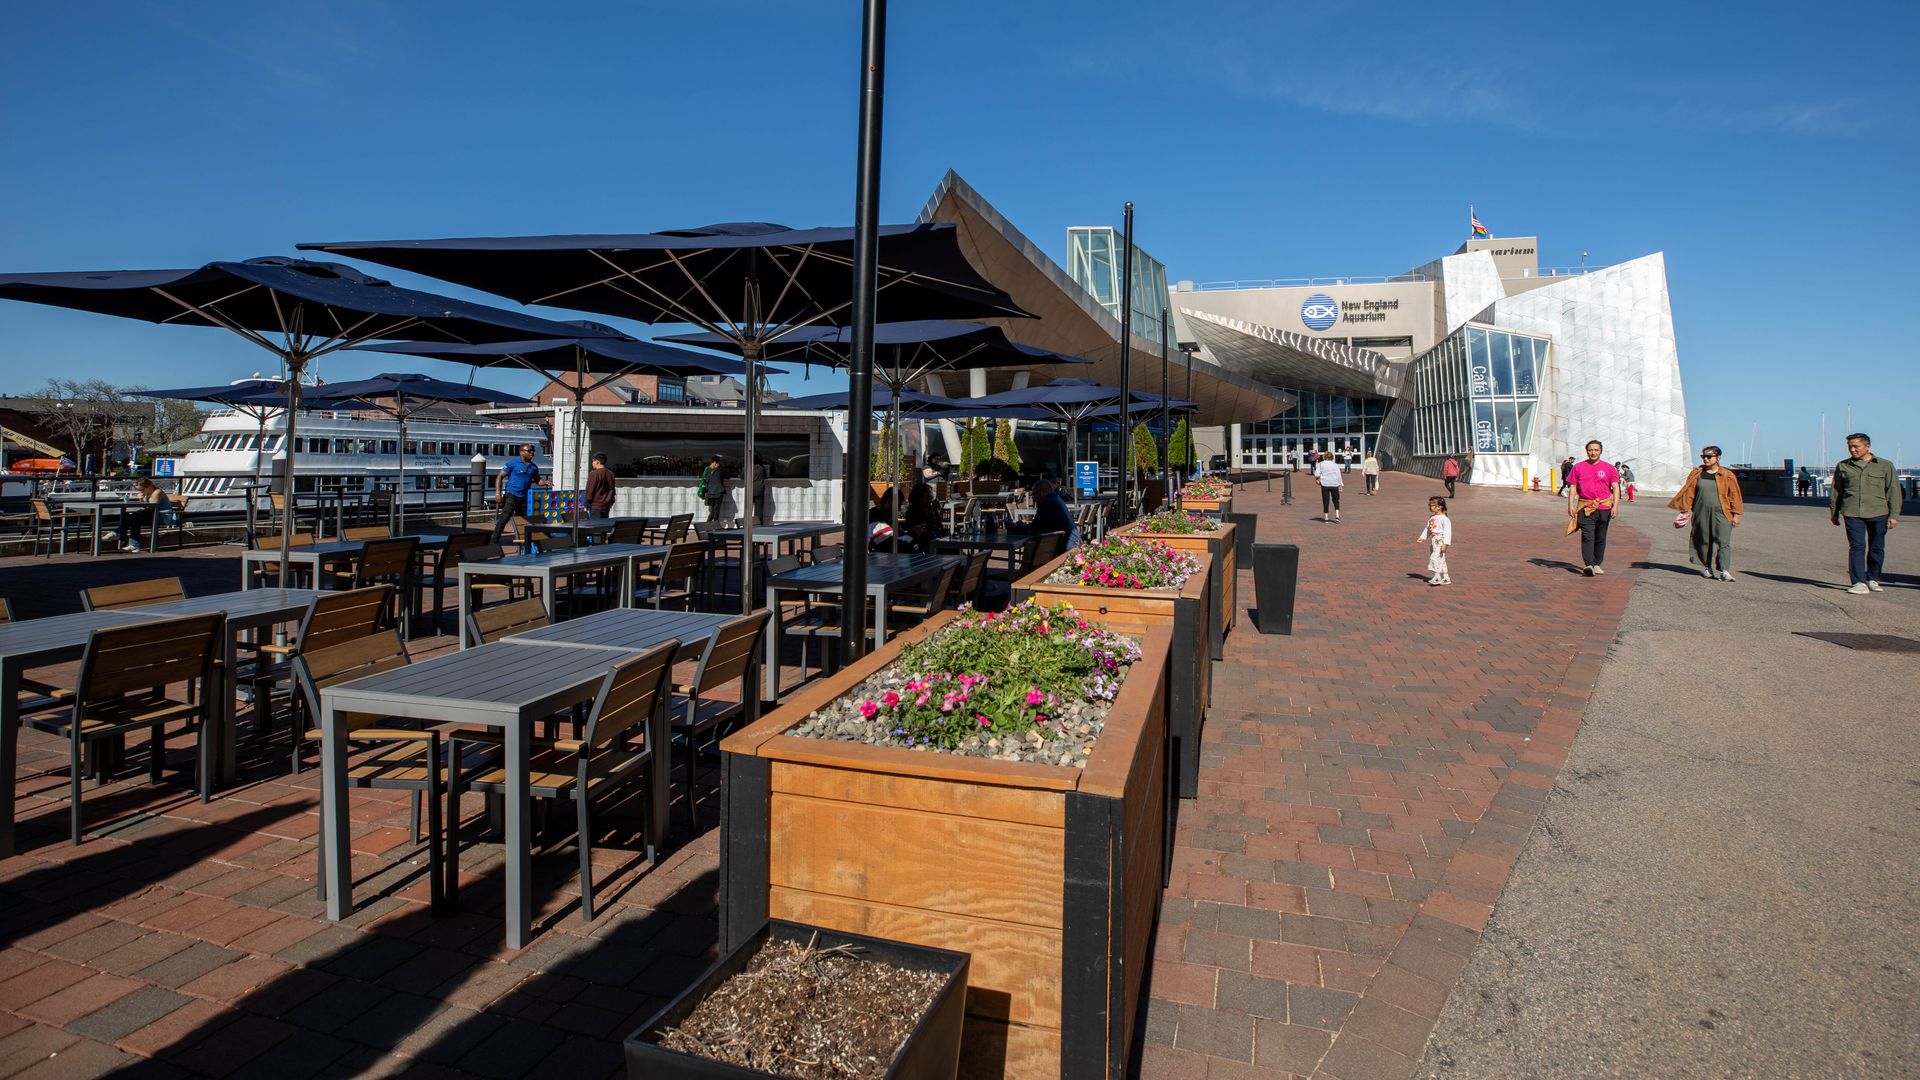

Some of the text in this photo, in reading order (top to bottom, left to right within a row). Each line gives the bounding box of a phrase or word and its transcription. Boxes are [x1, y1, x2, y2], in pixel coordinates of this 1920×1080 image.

[1474, 247, 1534, 256] arium
[1341, 298, 1399, 312] New England
[1342, 311, 1386, 325] Aquarium
[1472, 365, 1489, 393] Café
[1477, 420, 1492, 450] Gifts
